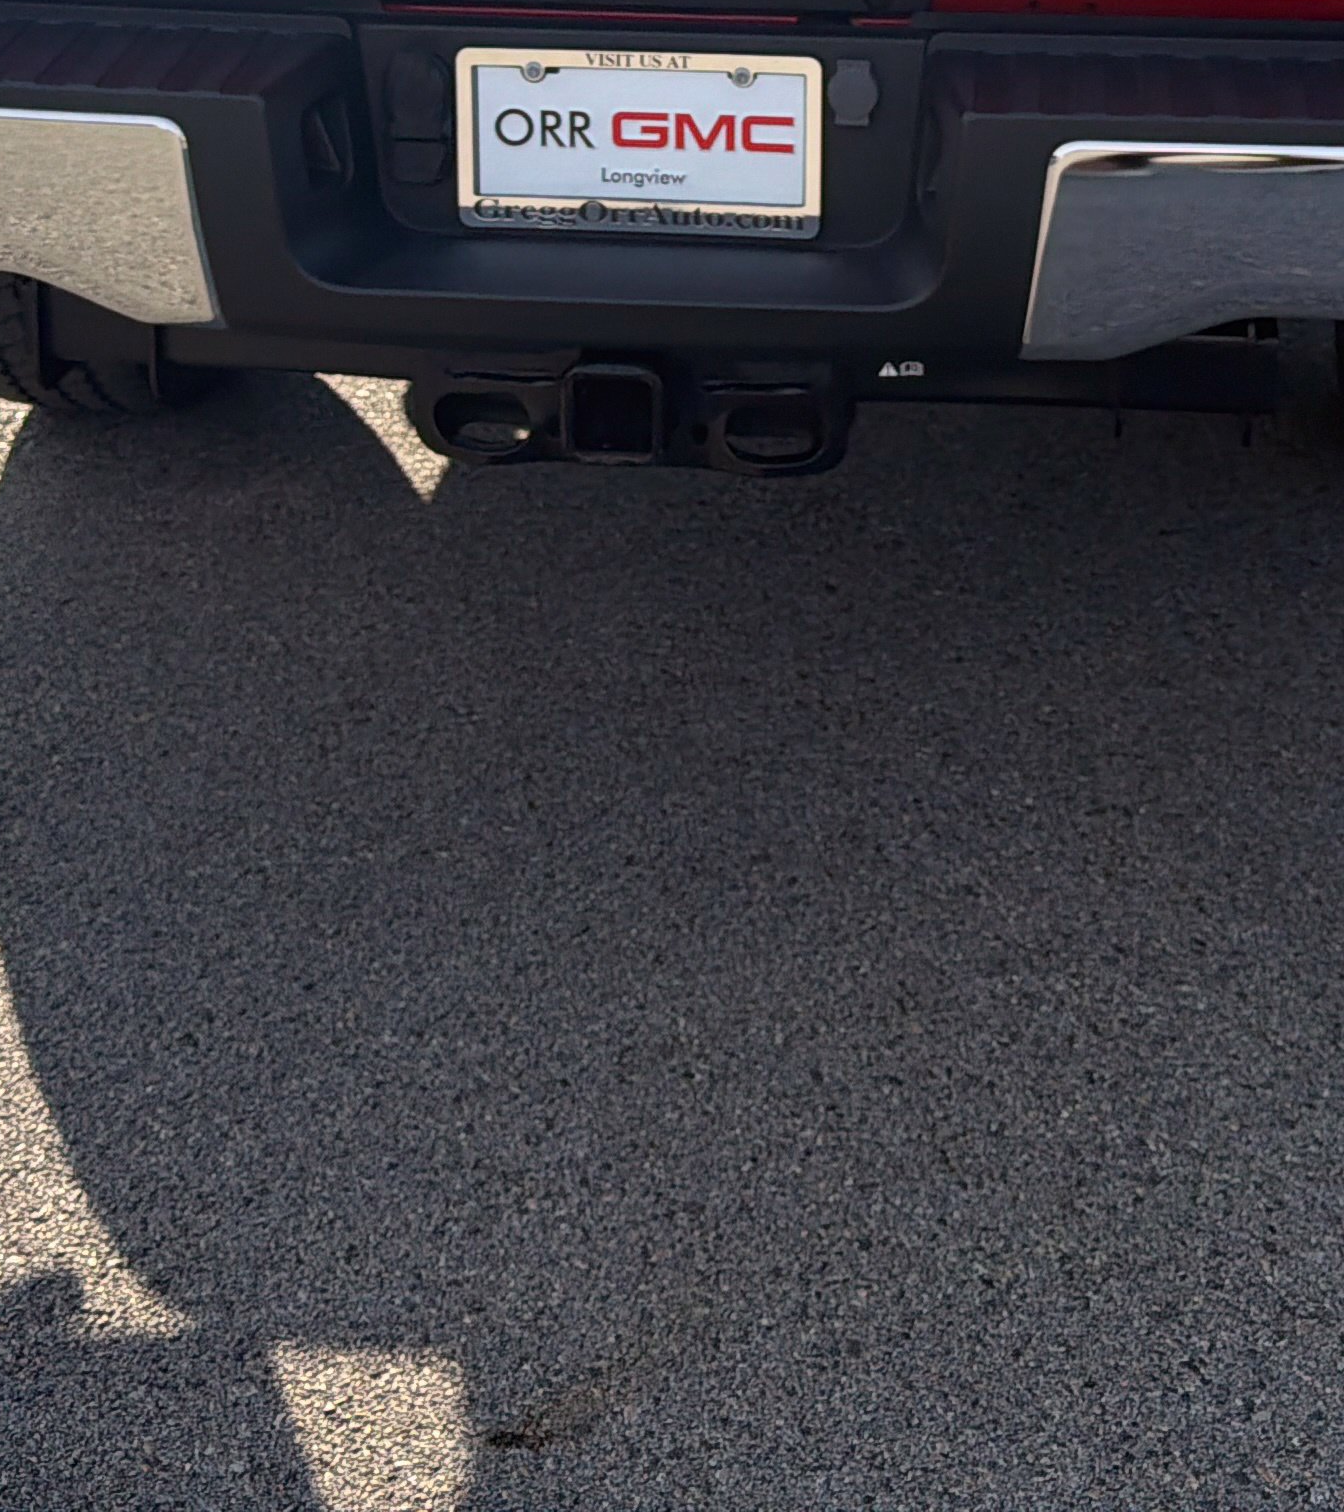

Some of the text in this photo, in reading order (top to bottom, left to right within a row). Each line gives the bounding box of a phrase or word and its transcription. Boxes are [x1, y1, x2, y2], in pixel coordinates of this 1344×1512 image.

[584, 52, 693, 70] VISIT US AT
[494, 108, 796, 155] ORR GMC
[600, 167, 687, 187] Longview
[472, 197, 806, 234] GreggOrrAuto.com
